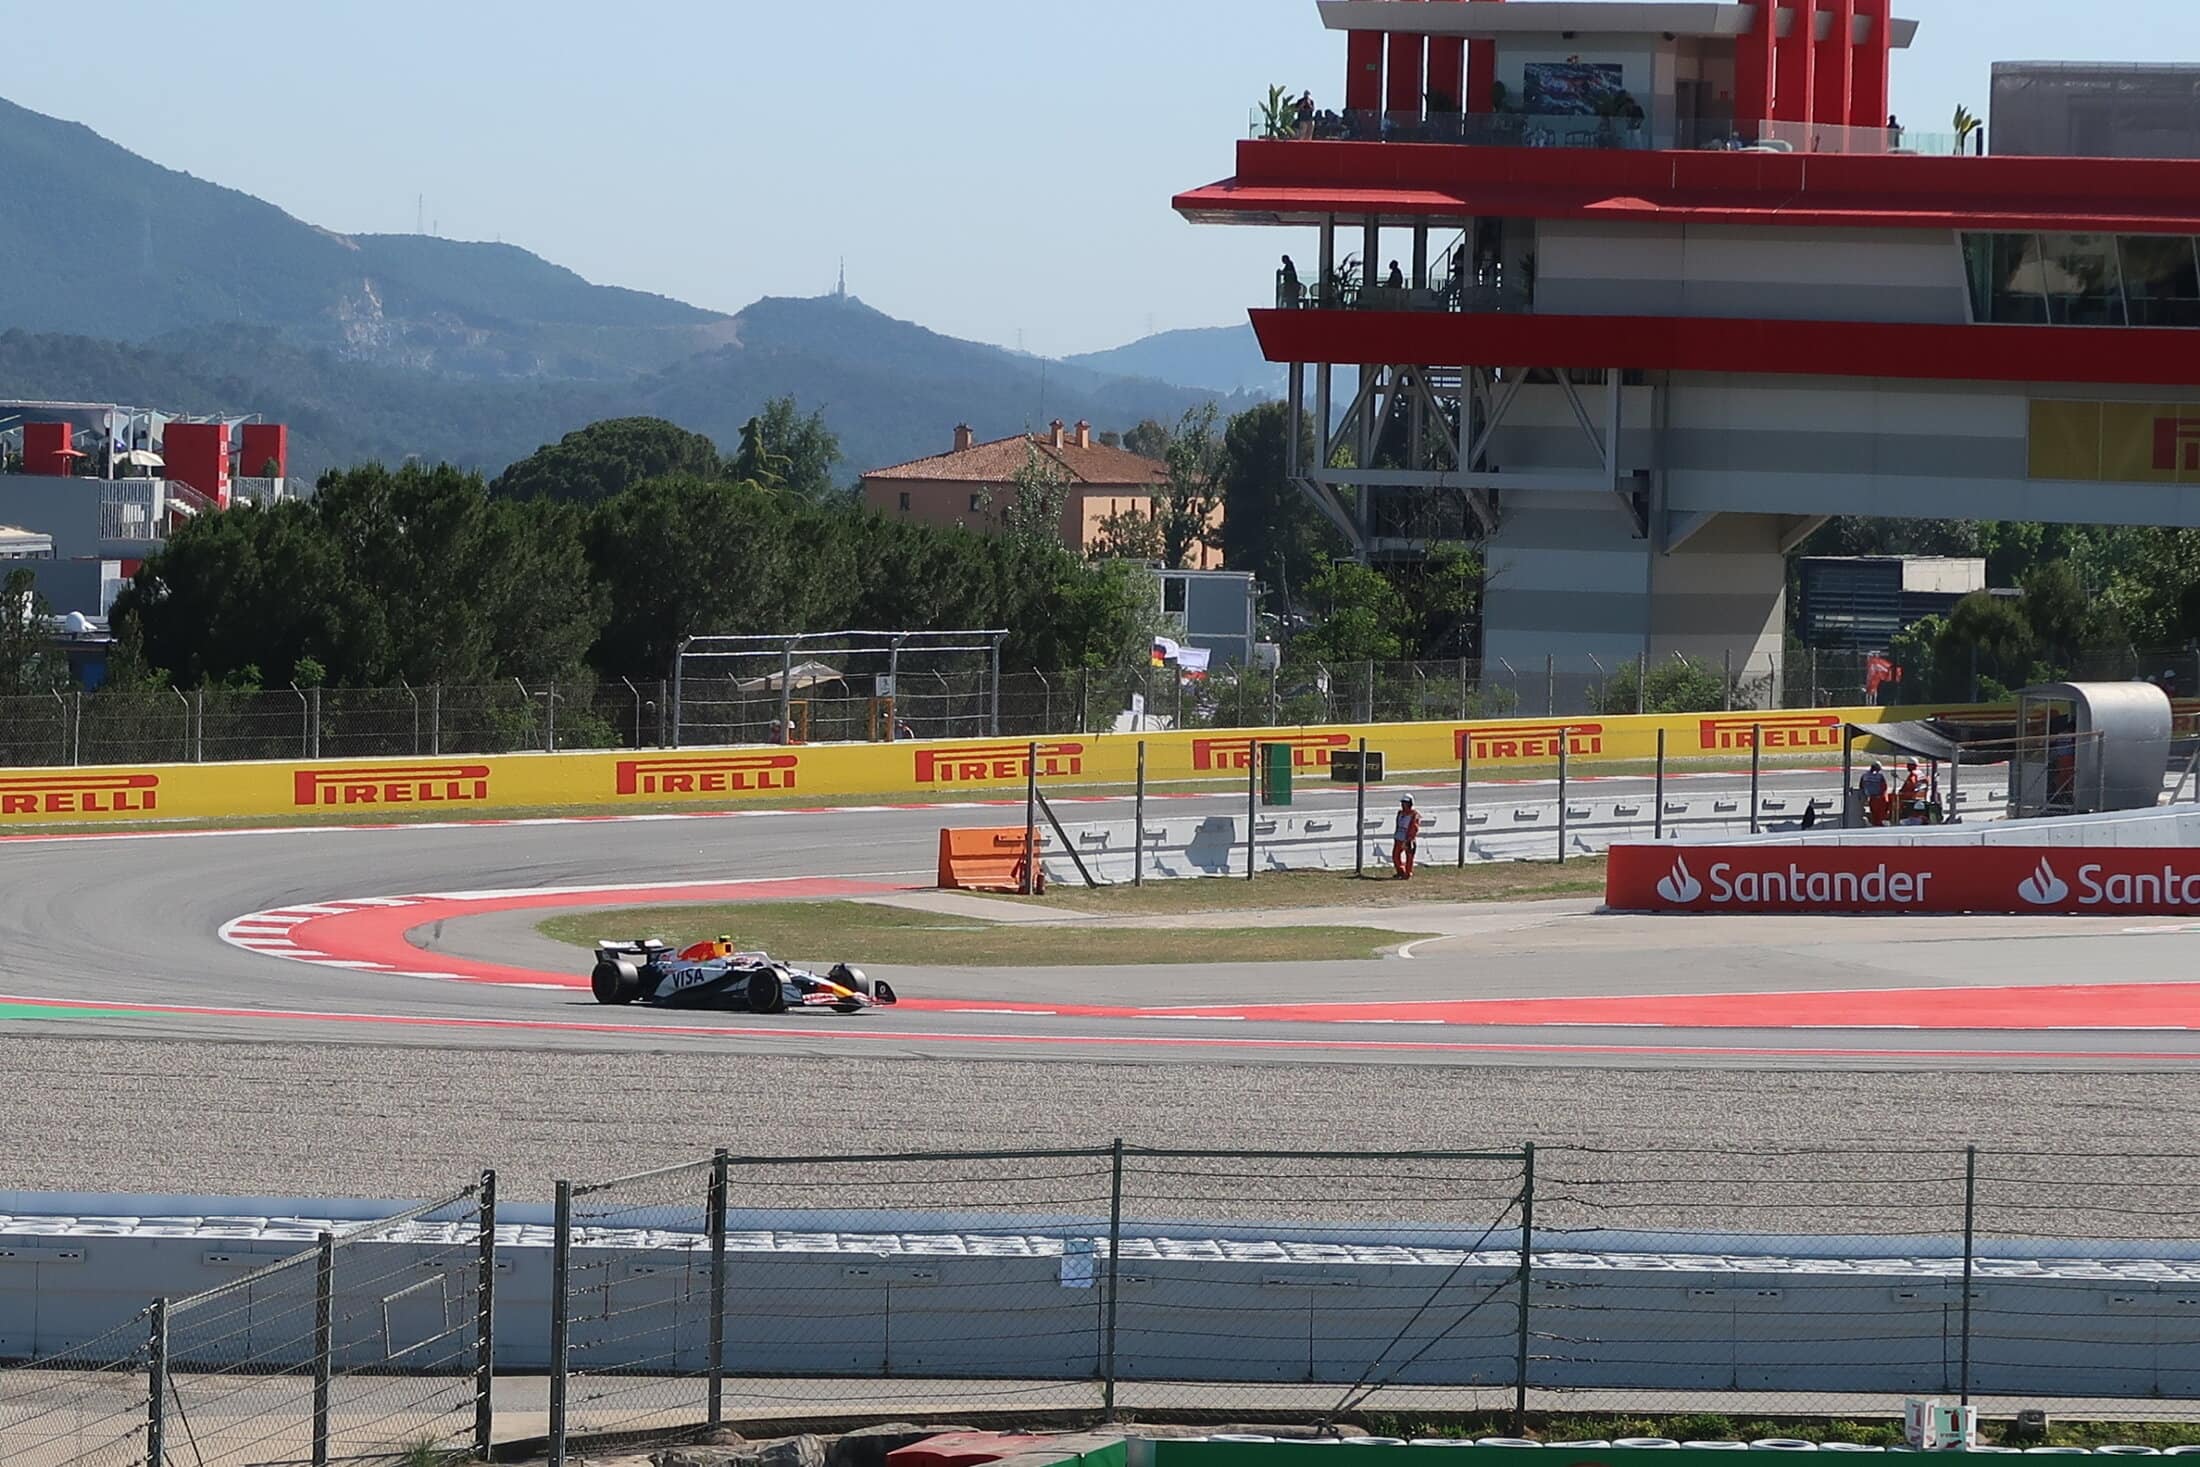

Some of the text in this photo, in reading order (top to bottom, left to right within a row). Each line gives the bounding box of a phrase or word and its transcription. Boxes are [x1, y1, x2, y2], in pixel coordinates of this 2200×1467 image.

[1193, 733, 1351, 770] PIRLL
[1454, 723, 1603, 760] PIRELLI
[1700, 716, 1840, 749] PIRELLI
[616, 755, 798, 795] PIRELLI
[914, 743, 1083, 782] PIRELLI
[294, 765, 490, 805] PIRELLI
[1710, 862, 1932, 902] Santander
[673, 968, 705, 988] VISA
